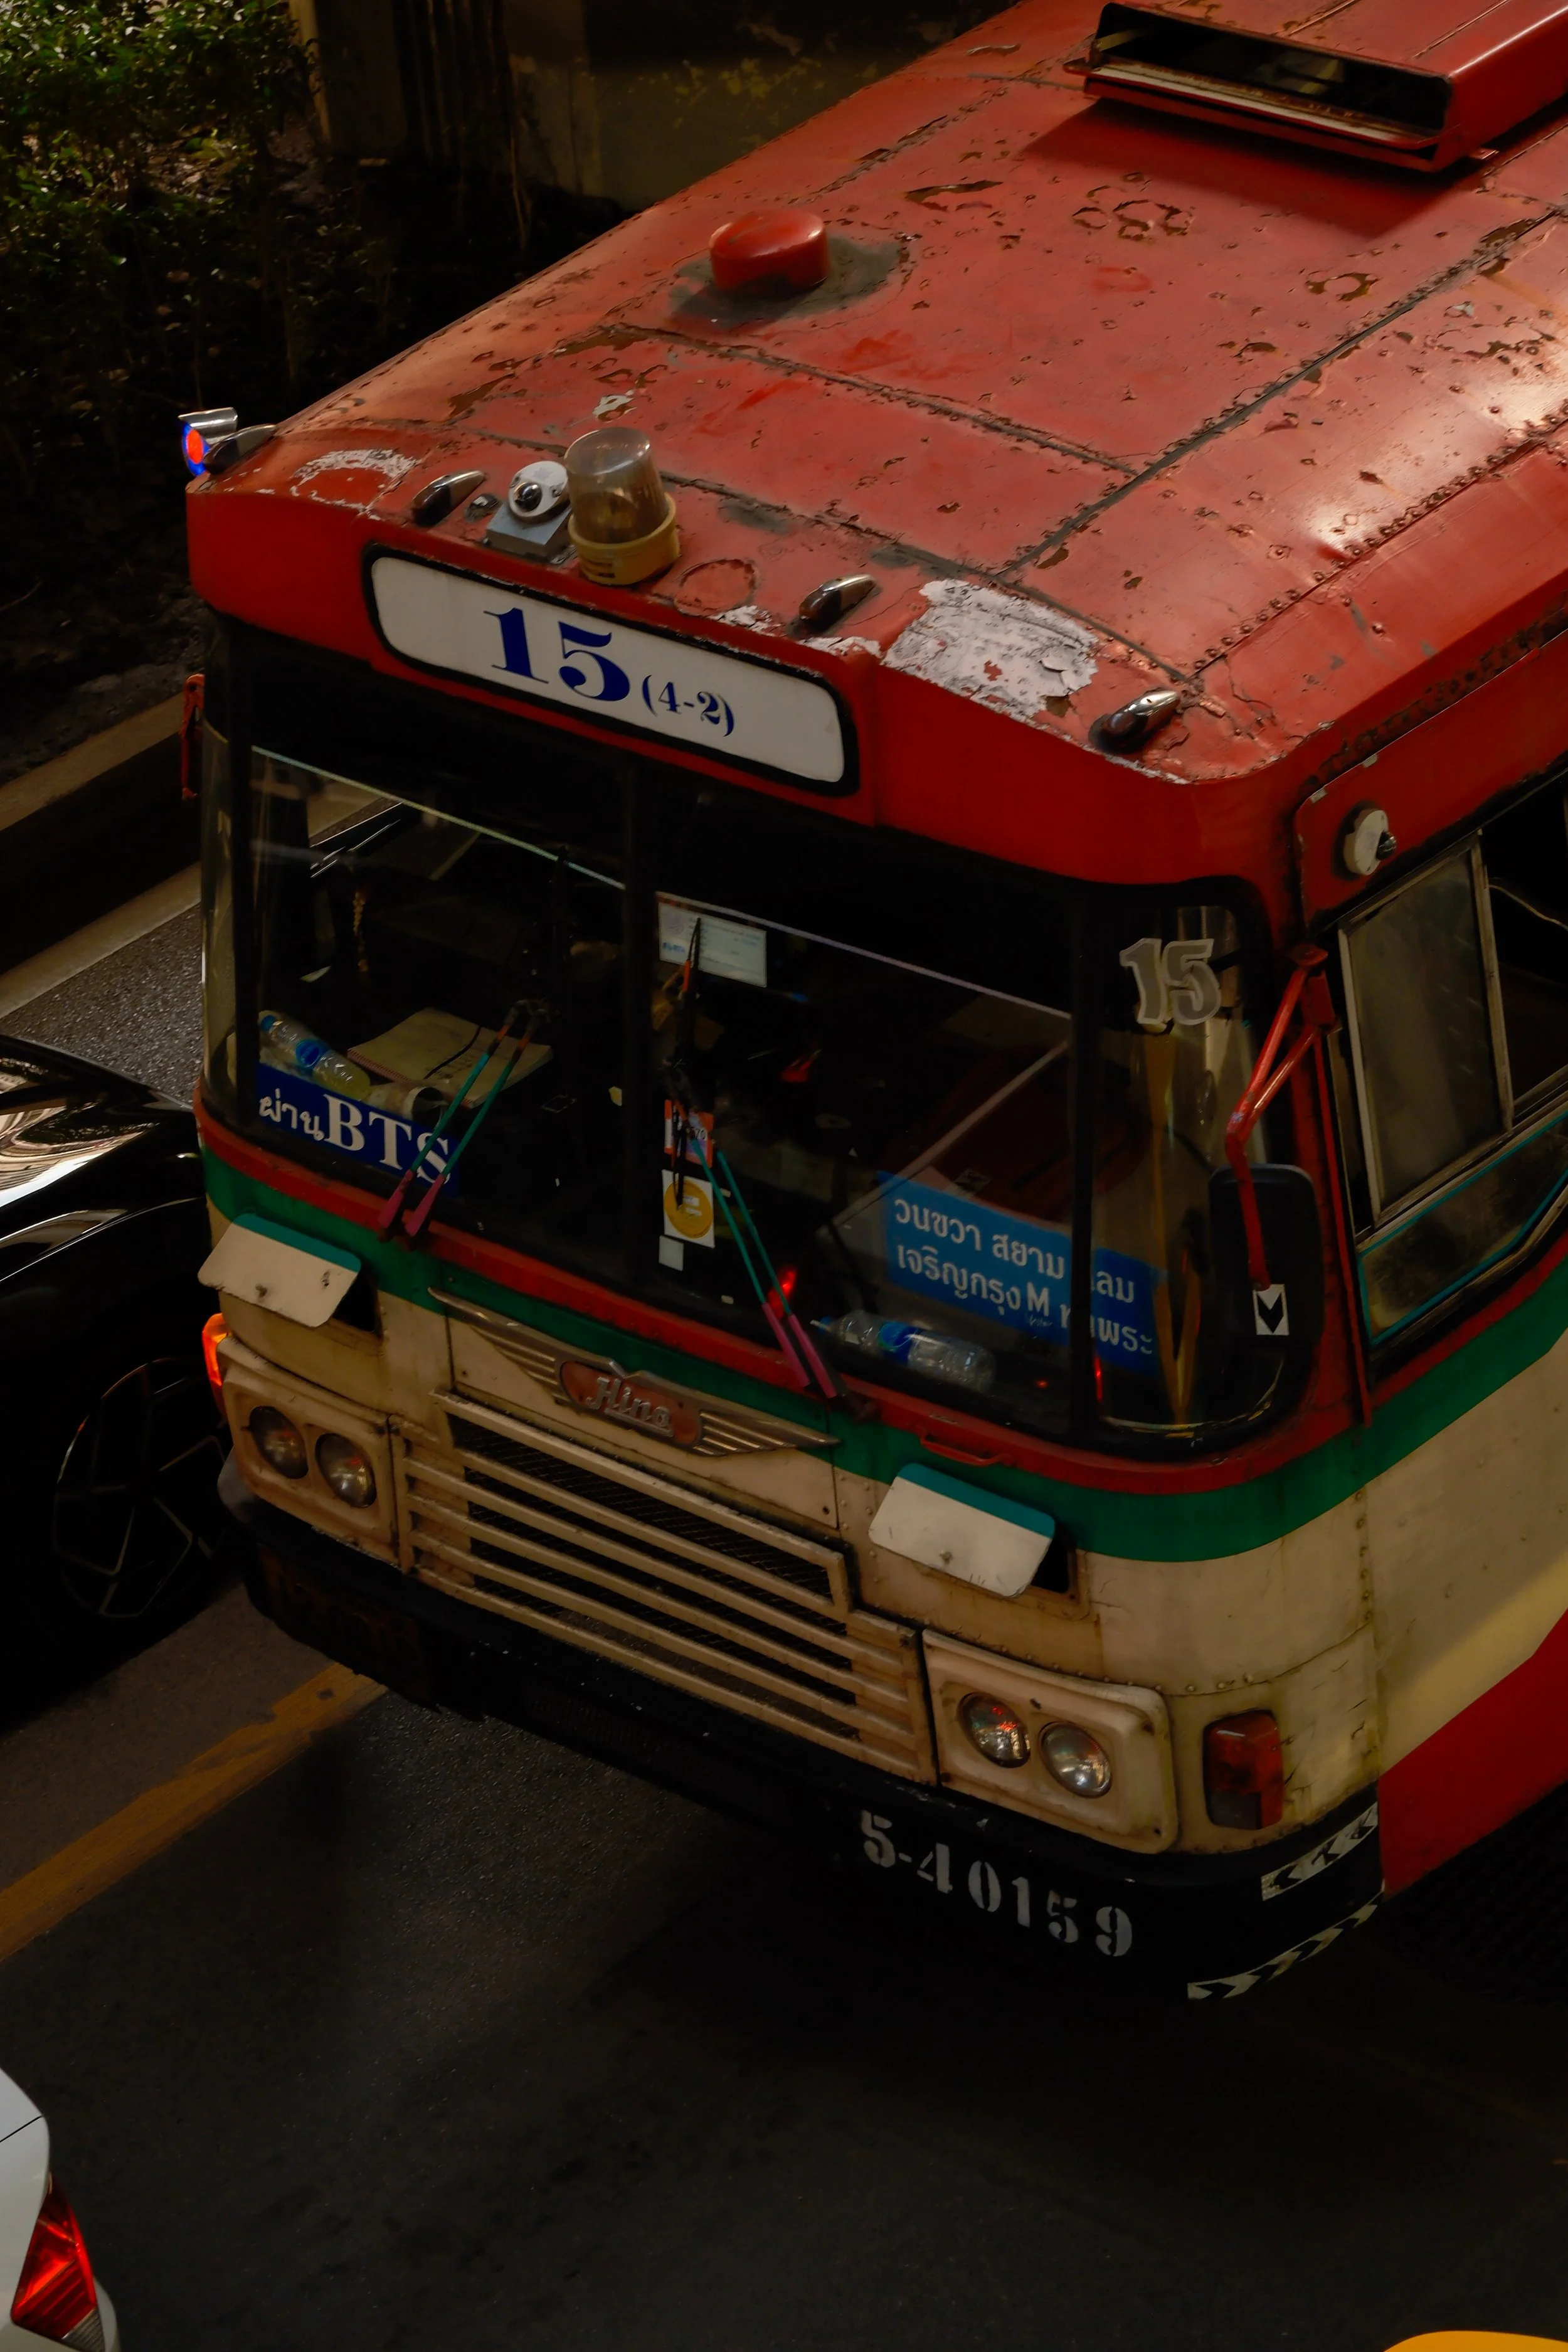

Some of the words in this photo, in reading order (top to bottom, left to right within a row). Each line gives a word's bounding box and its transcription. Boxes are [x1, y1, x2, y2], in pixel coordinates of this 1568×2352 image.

[483, 607, 630, 702] 15
[1118, 937, 1222, 1026] 15
[992, 1233, 1066, 1280] สยาม
[586, 1376, 671, 1428] Hino
[860, 1808, 1133, 1957] 5-40159
